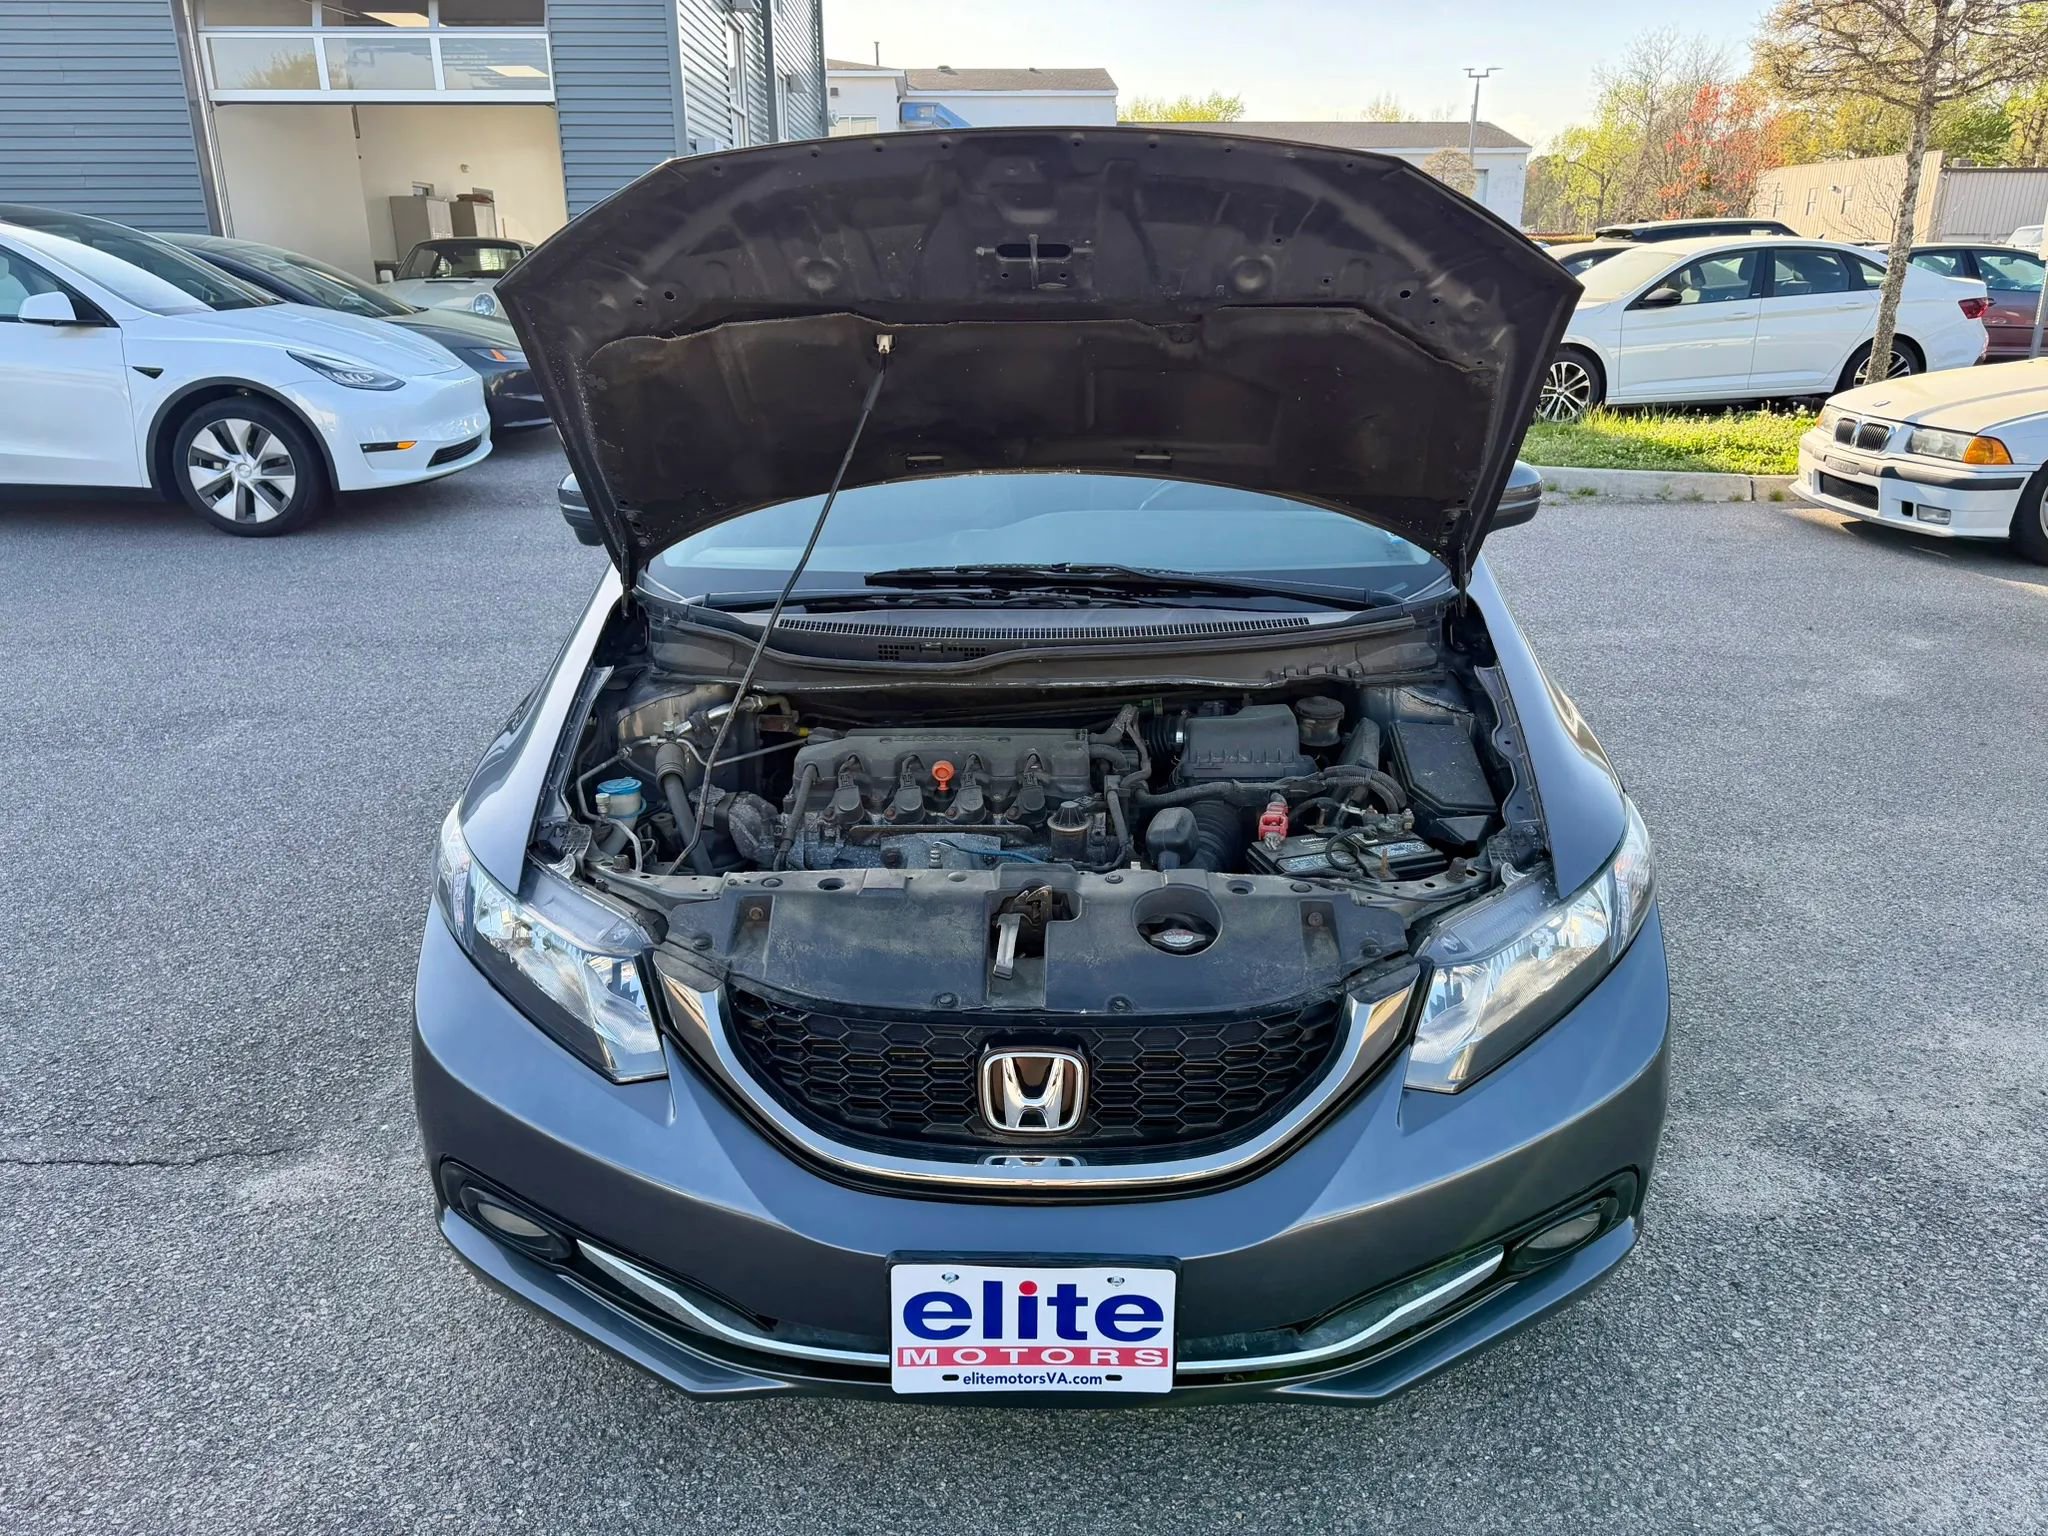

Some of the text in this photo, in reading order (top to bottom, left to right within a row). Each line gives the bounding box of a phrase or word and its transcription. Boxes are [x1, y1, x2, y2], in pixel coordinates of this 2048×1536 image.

[903, 1280, 1164, 1342] elite
[902, 1348, 1163, 1366] MOTORS
[962, 1372, 1103, 1386] elitemotorsVA.com
